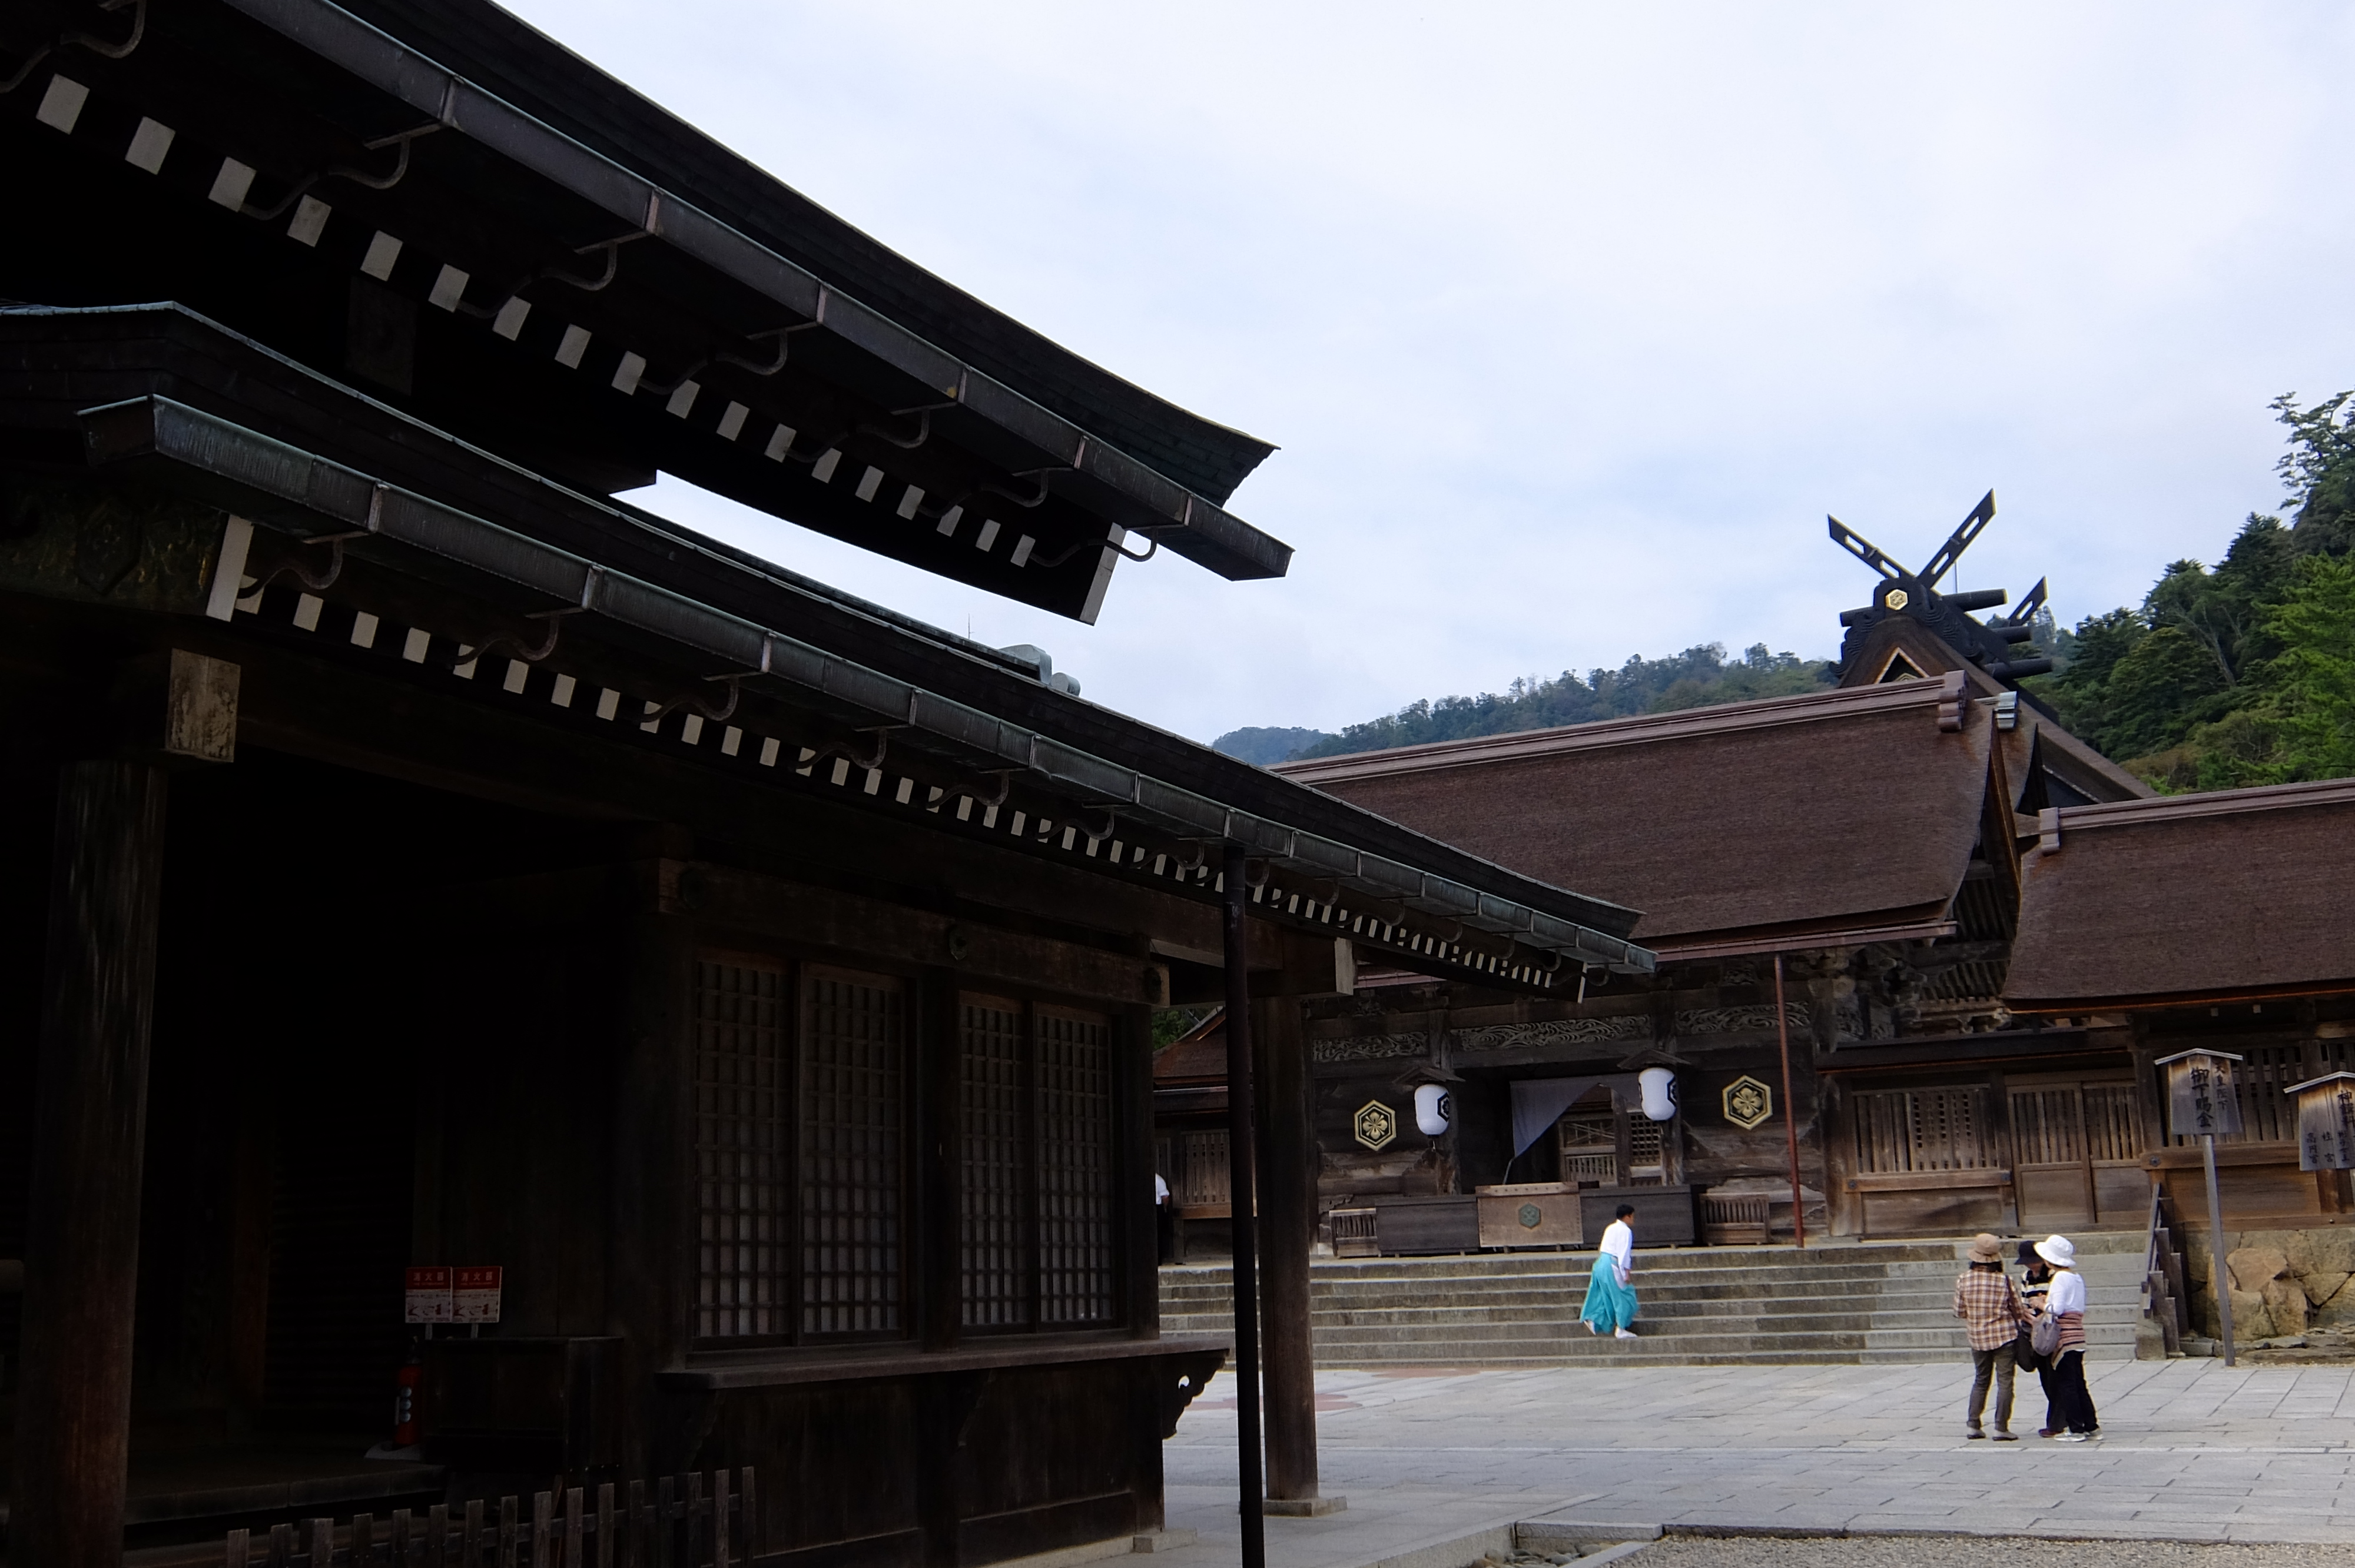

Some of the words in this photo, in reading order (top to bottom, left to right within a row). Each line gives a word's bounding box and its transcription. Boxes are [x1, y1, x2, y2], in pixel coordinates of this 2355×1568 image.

[2190, 1067, 2214, 1128] 御下賜金
[2214, 1061, 2228, 1110] 天皇陛下
[413, 1271, 445, 1282] 消火器
[460, 1271, 493, 1282] 消火器
